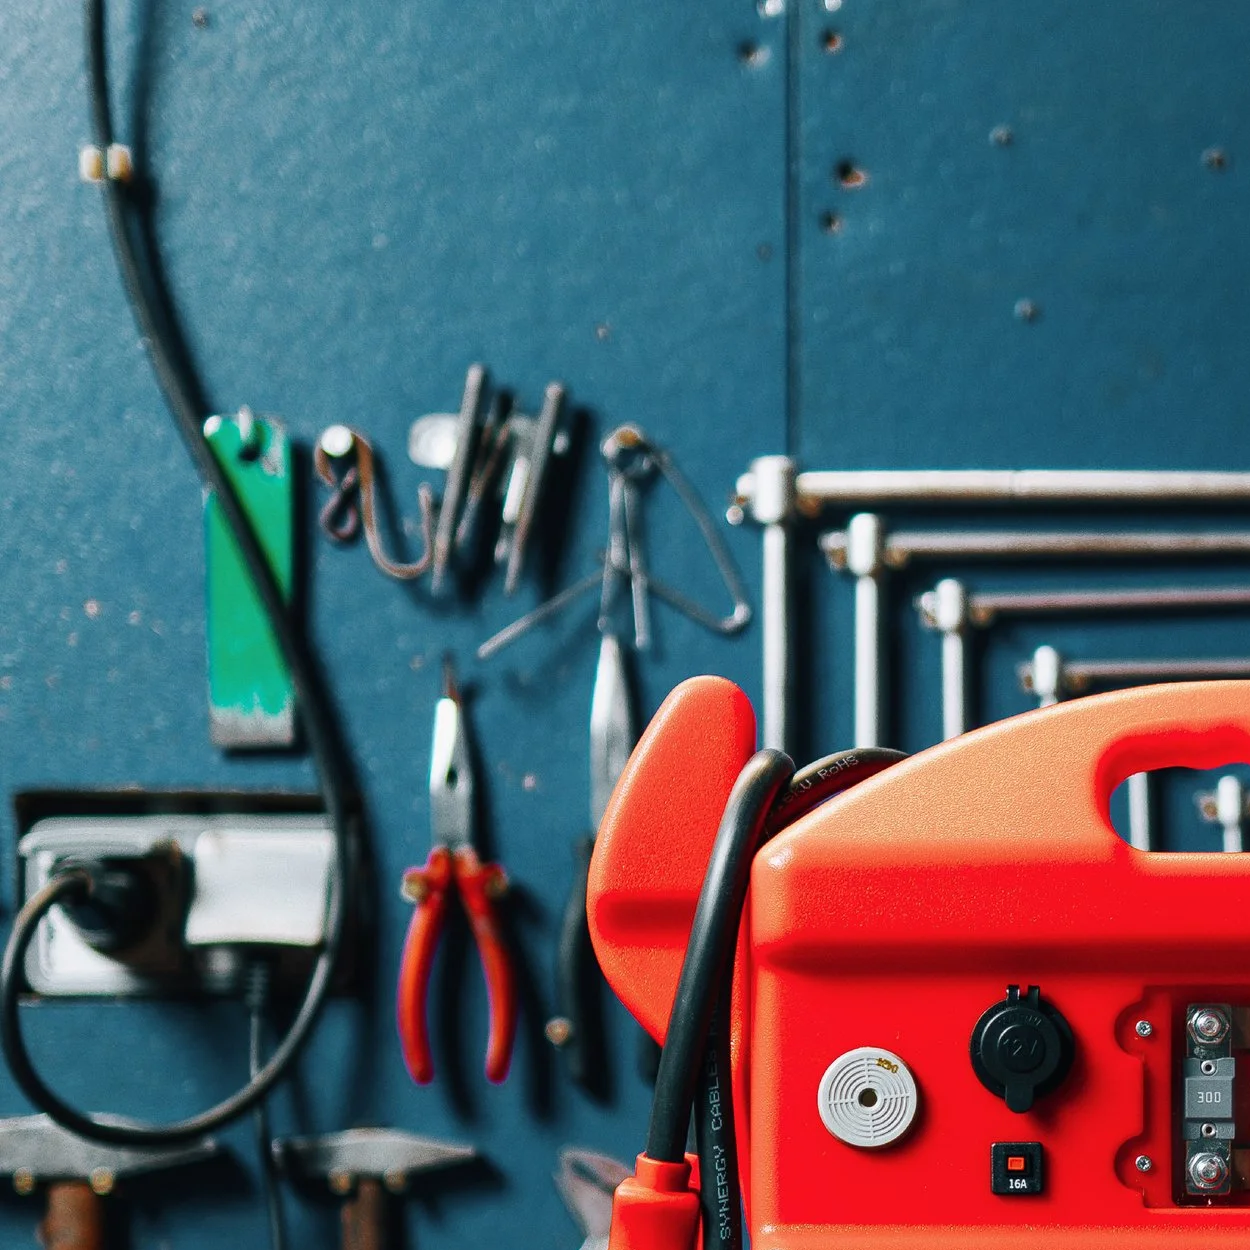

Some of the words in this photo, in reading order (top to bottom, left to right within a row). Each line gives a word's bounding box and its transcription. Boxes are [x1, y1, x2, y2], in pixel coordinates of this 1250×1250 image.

[817, 755, 859, 780] RoHS
[705, 1049, 723, 1131] CABLES
[1197, 1091, 1222, 1103] 300
[714, 1145, 732, 1240] SYNERGY
[1009, 1178, 1028, 1189] 16A
